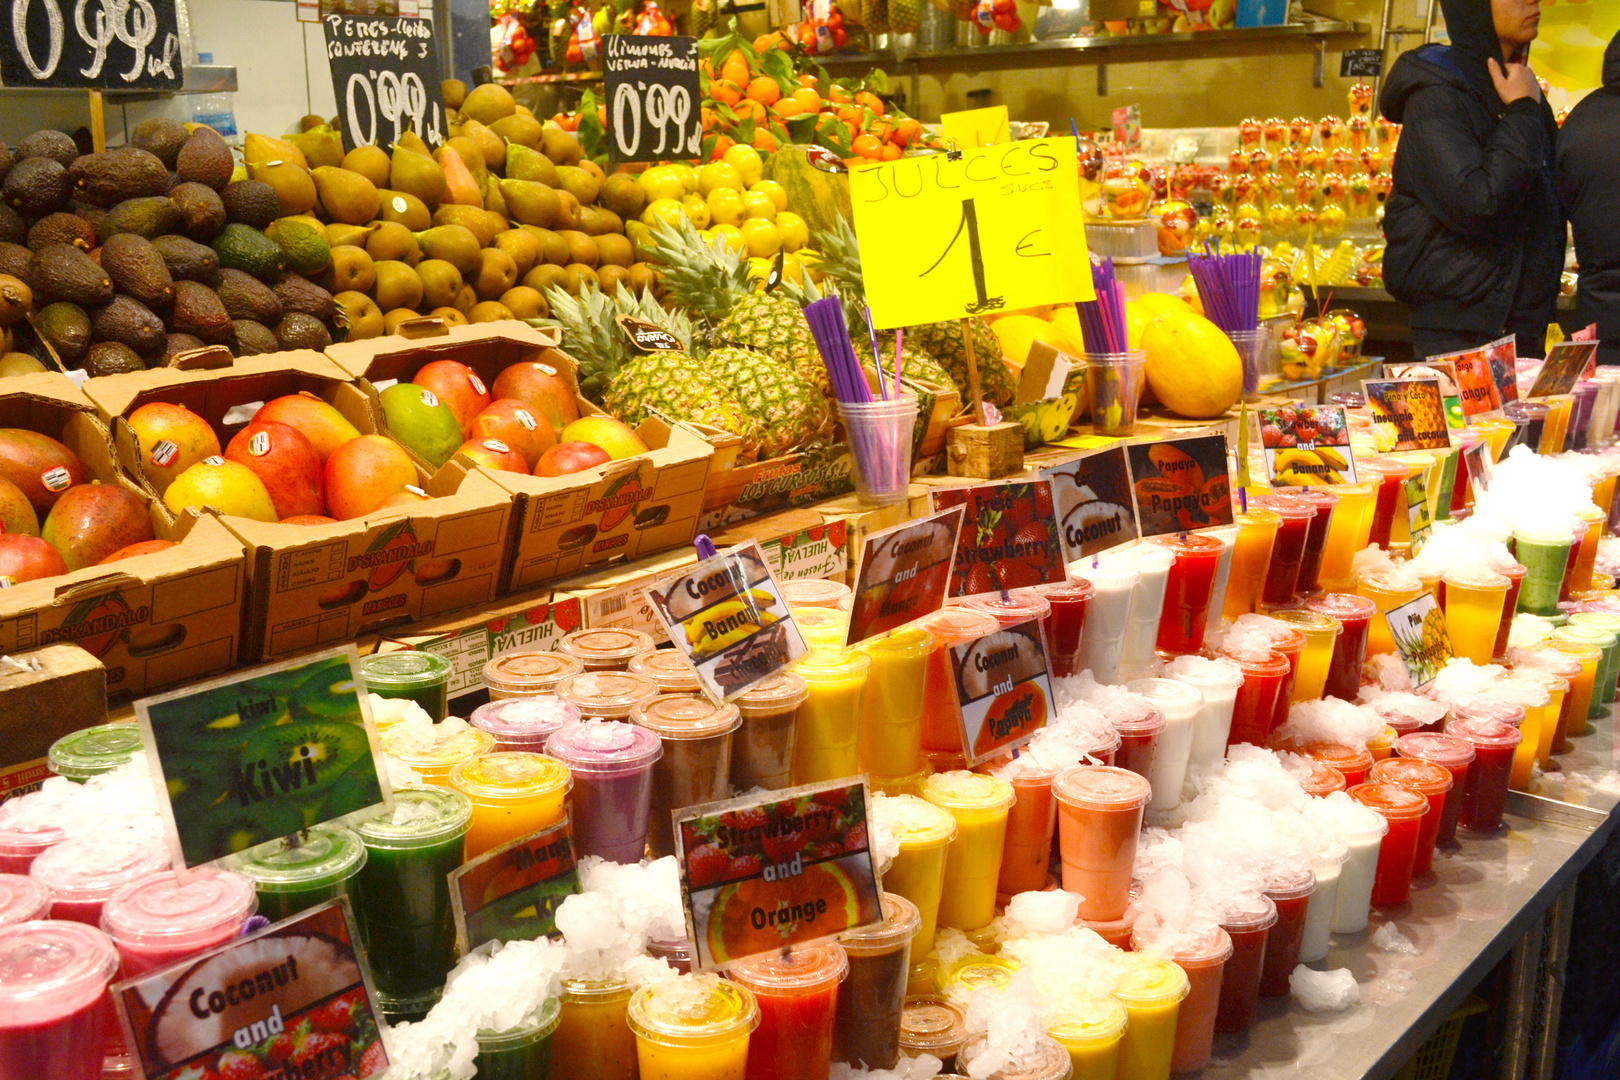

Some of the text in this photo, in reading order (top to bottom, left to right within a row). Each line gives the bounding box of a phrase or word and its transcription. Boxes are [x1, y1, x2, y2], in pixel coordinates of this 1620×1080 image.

[1001, 180, 1054, 196] SUCS
[918, 198, 1052, 314] 1 €
[1372, 410, 1414, 425] ineapple
[1297, 439, 1315, 451] and
[1418, 430, 1448, 440] coconu
[753, 463, 801, 482] Frutas
[1158, 458, 1196, 473] Papaya
[1292, 462, 1331, 474] Banana
[738, 480, 768, 502] LOS
[769, 465, 828, 495] CURSOS
[1151, 492, 1210, 513] Papaya
[1065, 512, 1122, 548] Coconut
[347, 540, 432, 573] D'SKANDALO
[787, 540, 828, 564] HUELVA
[891, 531, 935, 558] Coconut
[956, 537, 1049, 565] Strawberry
[895, 561, 918, 583] and
[498, 623, 553, 652] HUELVA
[974, 642, 1020, 673] Coconut
[993, 674, 1014, 698] and
[234, 746, 317, 807] Kiwi
[715, 809, 834, 849] Strawberry
[516, 838, 571, 872] Mang
[763, 852, 803, 882] and
[751, 899, 827, 930] Orange
[190, 954, 299, 1019] Coconut
[234, 1003, 285, 1049] and
